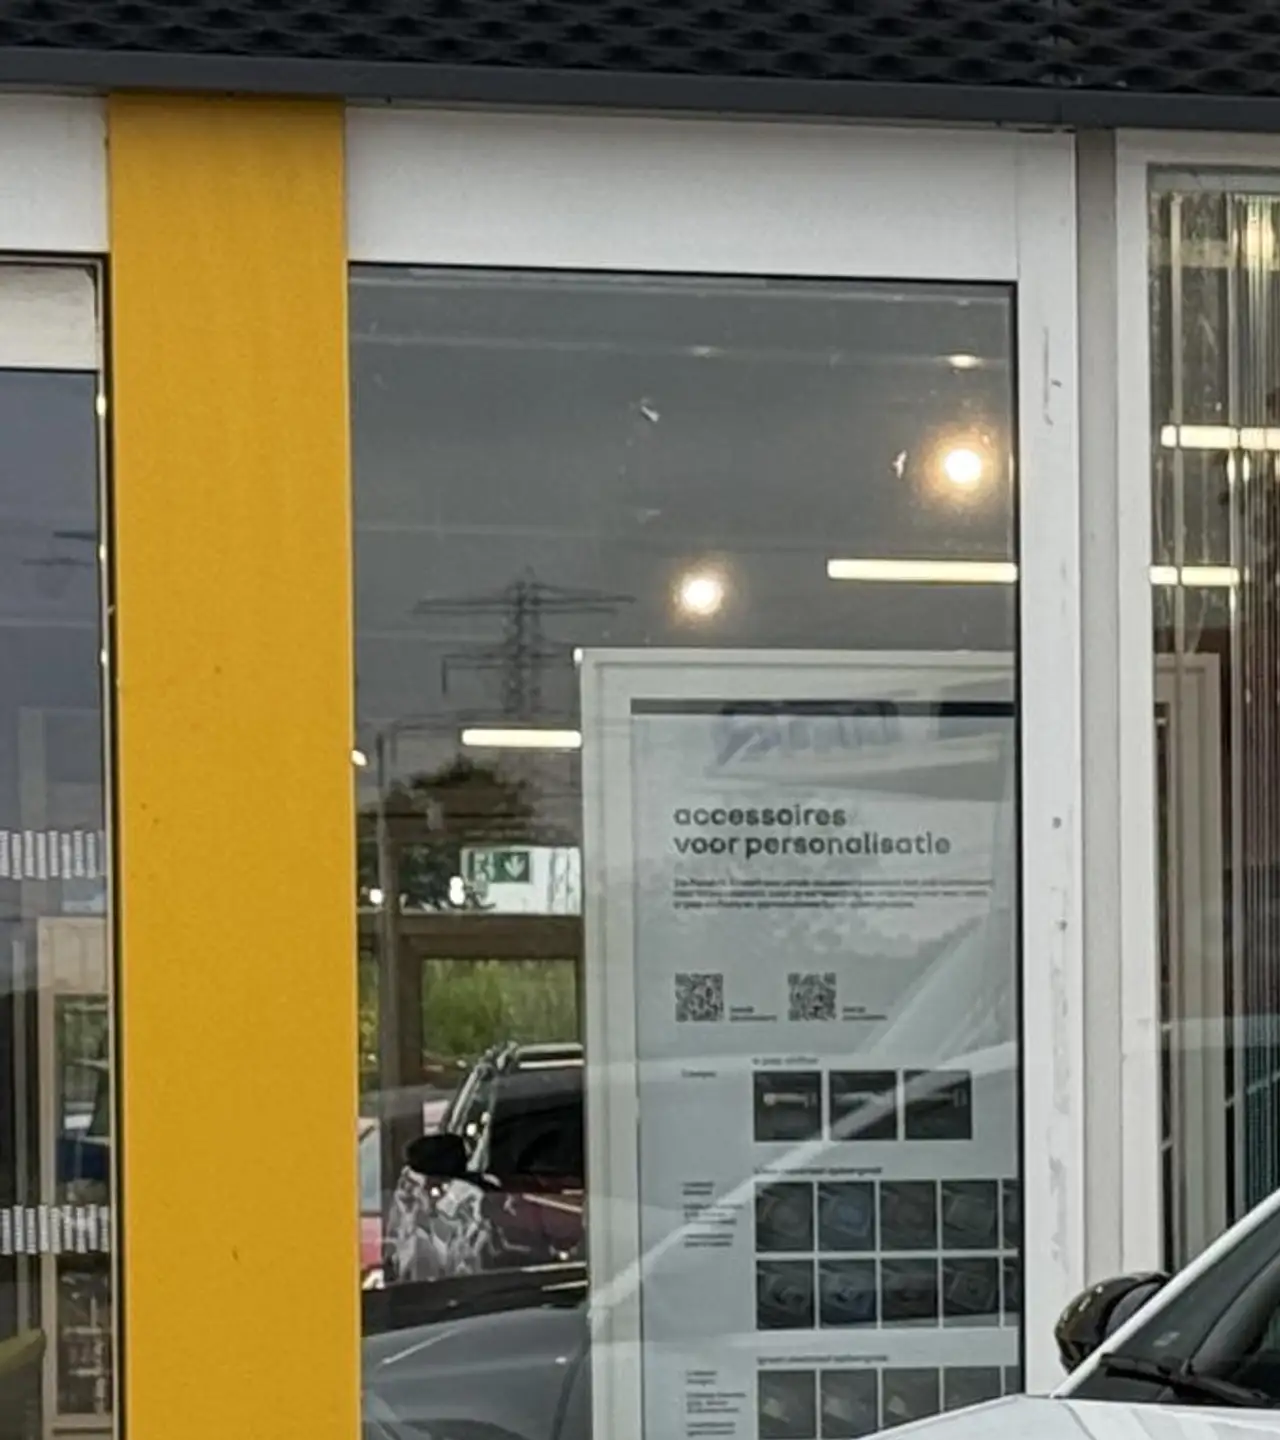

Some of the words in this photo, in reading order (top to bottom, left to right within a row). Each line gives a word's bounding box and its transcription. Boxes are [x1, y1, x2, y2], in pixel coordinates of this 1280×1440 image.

[673, 804, 847, 826] accessoires
[673, 836, 740, 854] voor
[745, 832, 951, 859] personalisatie
